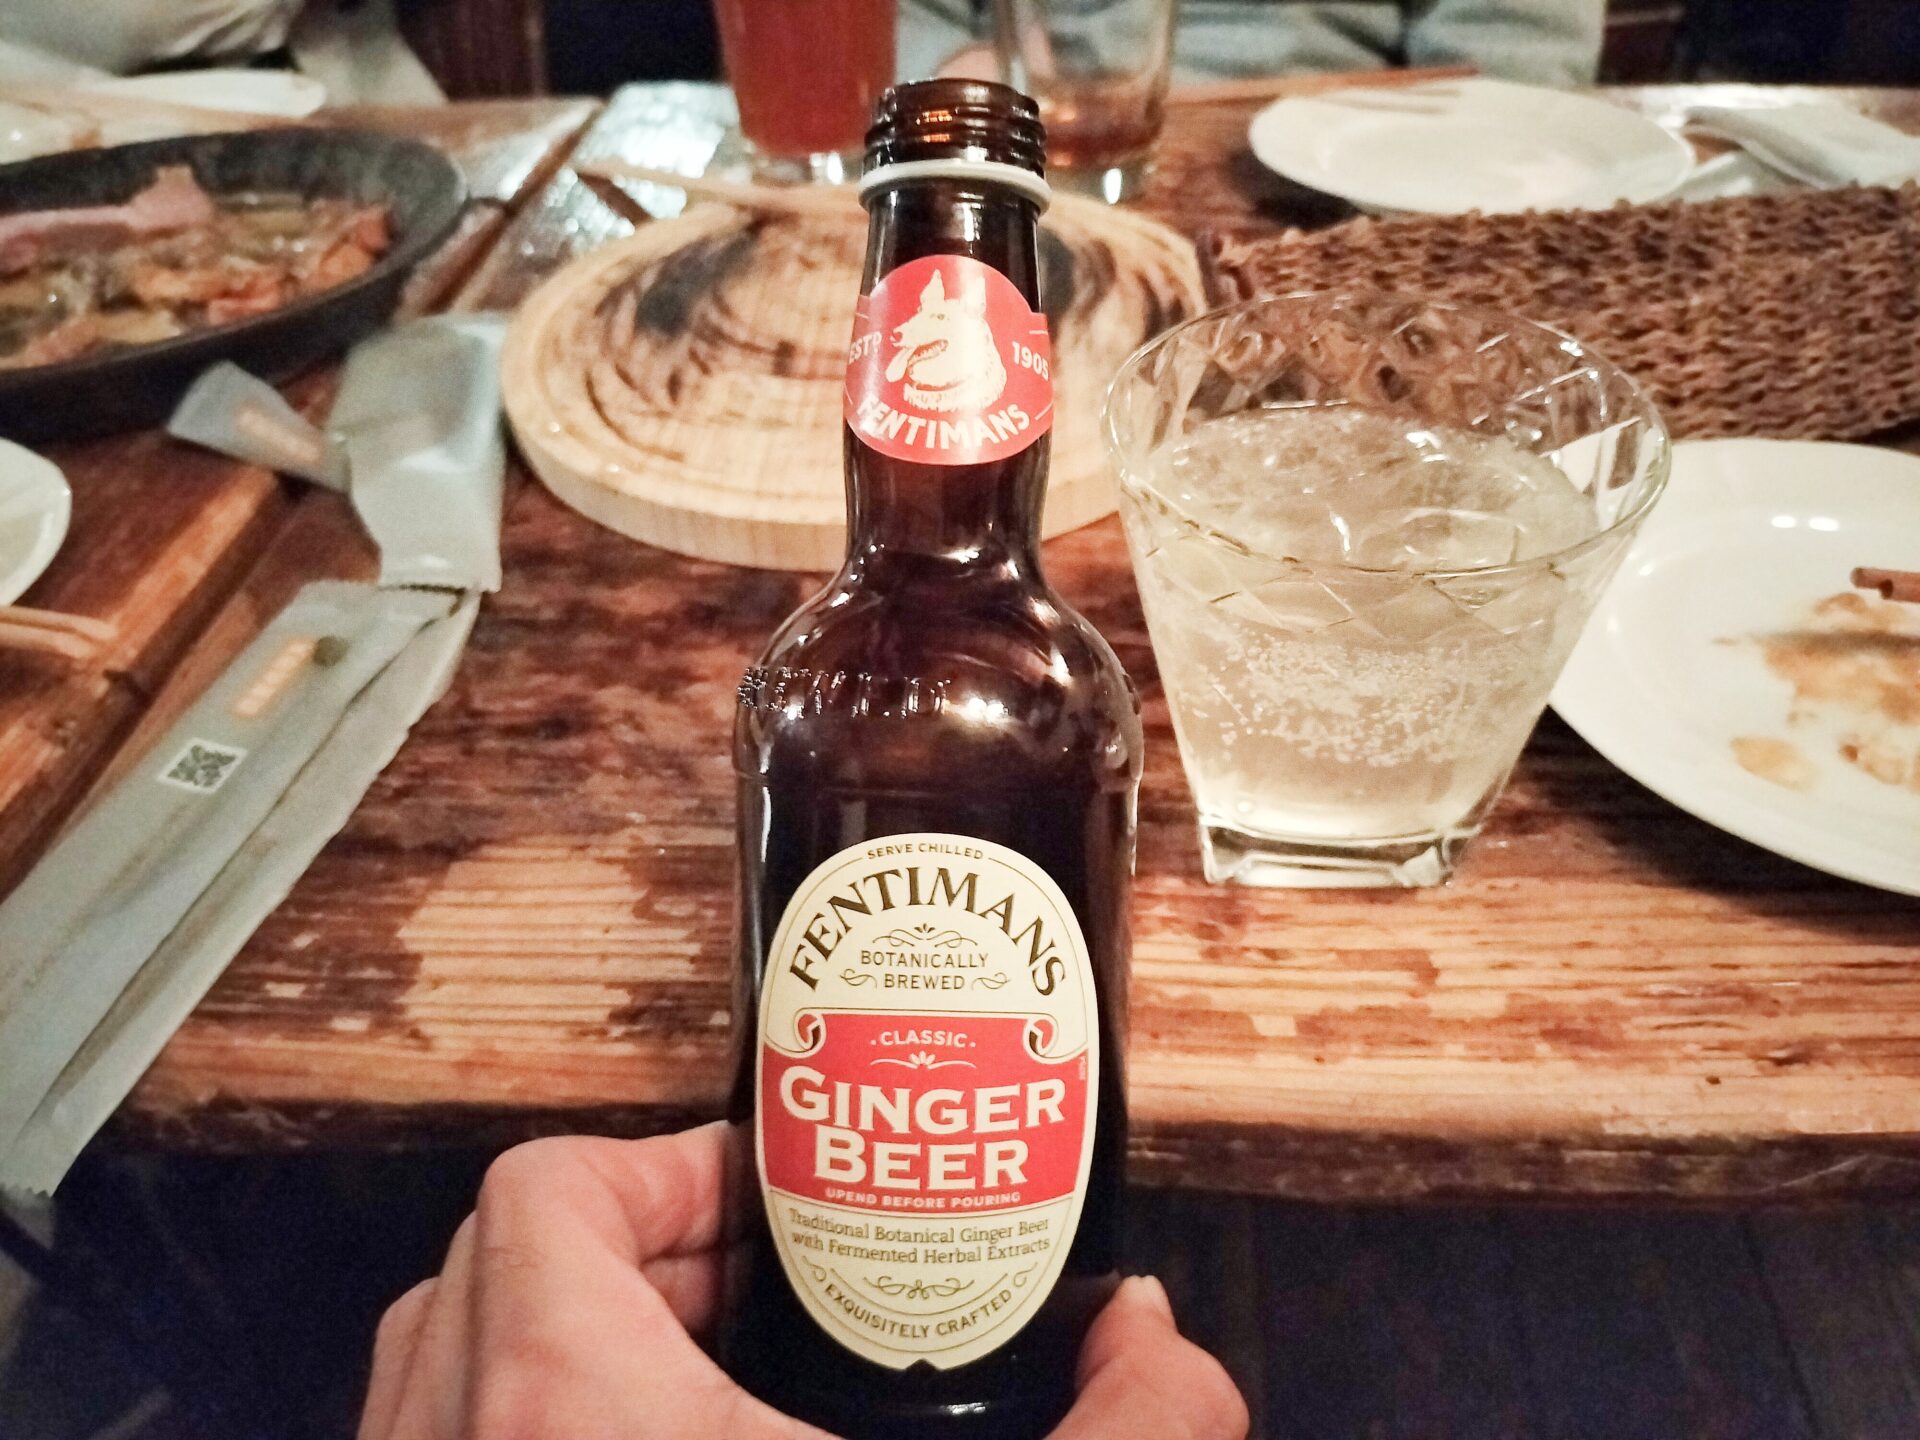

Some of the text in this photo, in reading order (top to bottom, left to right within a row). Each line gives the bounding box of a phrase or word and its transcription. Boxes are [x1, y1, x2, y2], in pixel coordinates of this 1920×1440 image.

[1011, 341, 1049, 381] 1905
[867, 843, 984, 860] SERVE CHILLED
[789, 867, 1066, 996] FENTIMANS
[861, 950, 988, 968] BOTANICALLY
[884, 973, 965, 990] BREWED
[779, 1065, 1067, 1134] GINGER
[814, 1124, 1029, 1190] BEER
[825, 1188, 1021, 1209] UPEND BEFORE POURING
[789, 1207, 1049, 1244] Traditional Botanical Ginger Beer
[792, 1232, 1050, 1263] with Fermented Herbal Extracts
[824, 1283, 1012, 1338] EXQUISITELY CRAFTED
